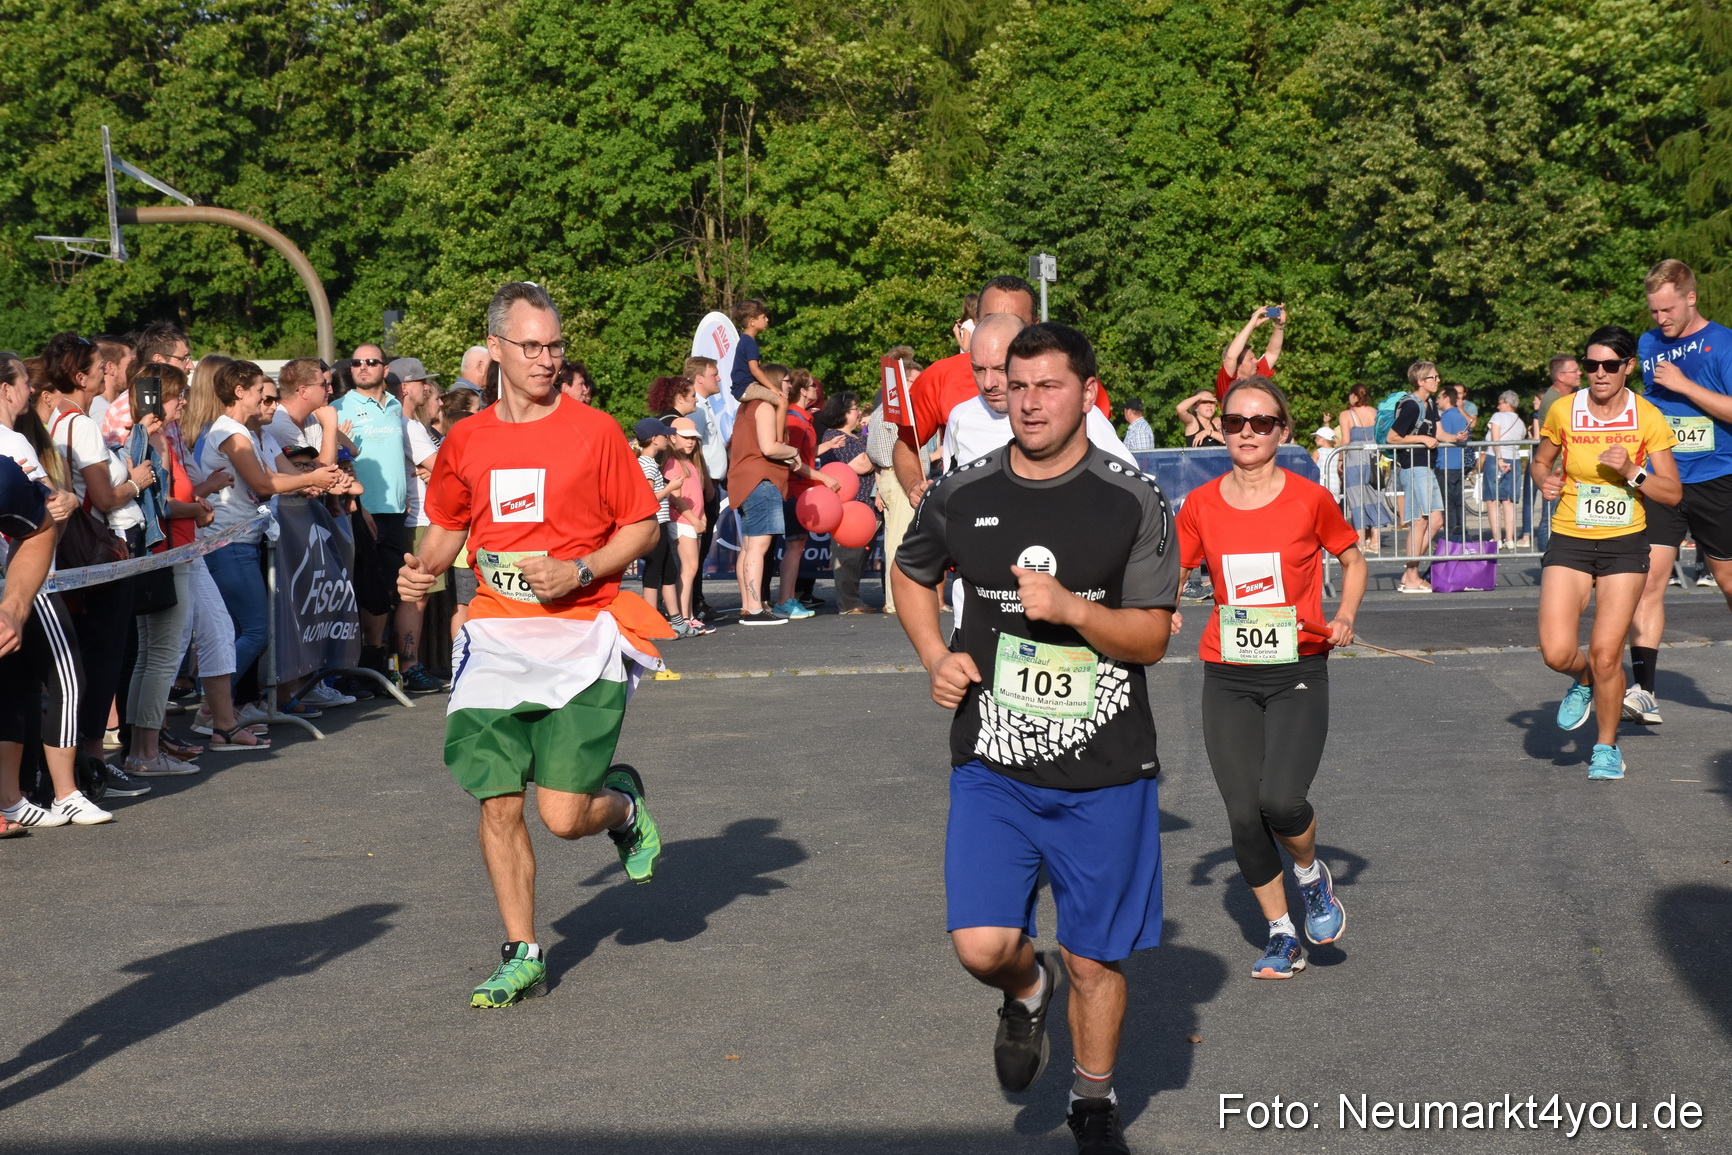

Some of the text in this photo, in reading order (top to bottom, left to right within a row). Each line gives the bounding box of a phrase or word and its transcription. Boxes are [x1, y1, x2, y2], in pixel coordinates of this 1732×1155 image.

[1572, 433, 1639, 444] MAX BÖGL
[1672, 429, 1706, 442] 047
[1584, 499, 1627, 516] 1680
[974, 517, 1000, 527] JAKO
[492, 571, 532, 592] 478
[1245, 582, 1264, 594] DEHN
[1235, 627, 1280, 649] 504
[1016, 667, 1073, 699] 103
[999, 687, 1036, 703] Munteanu
